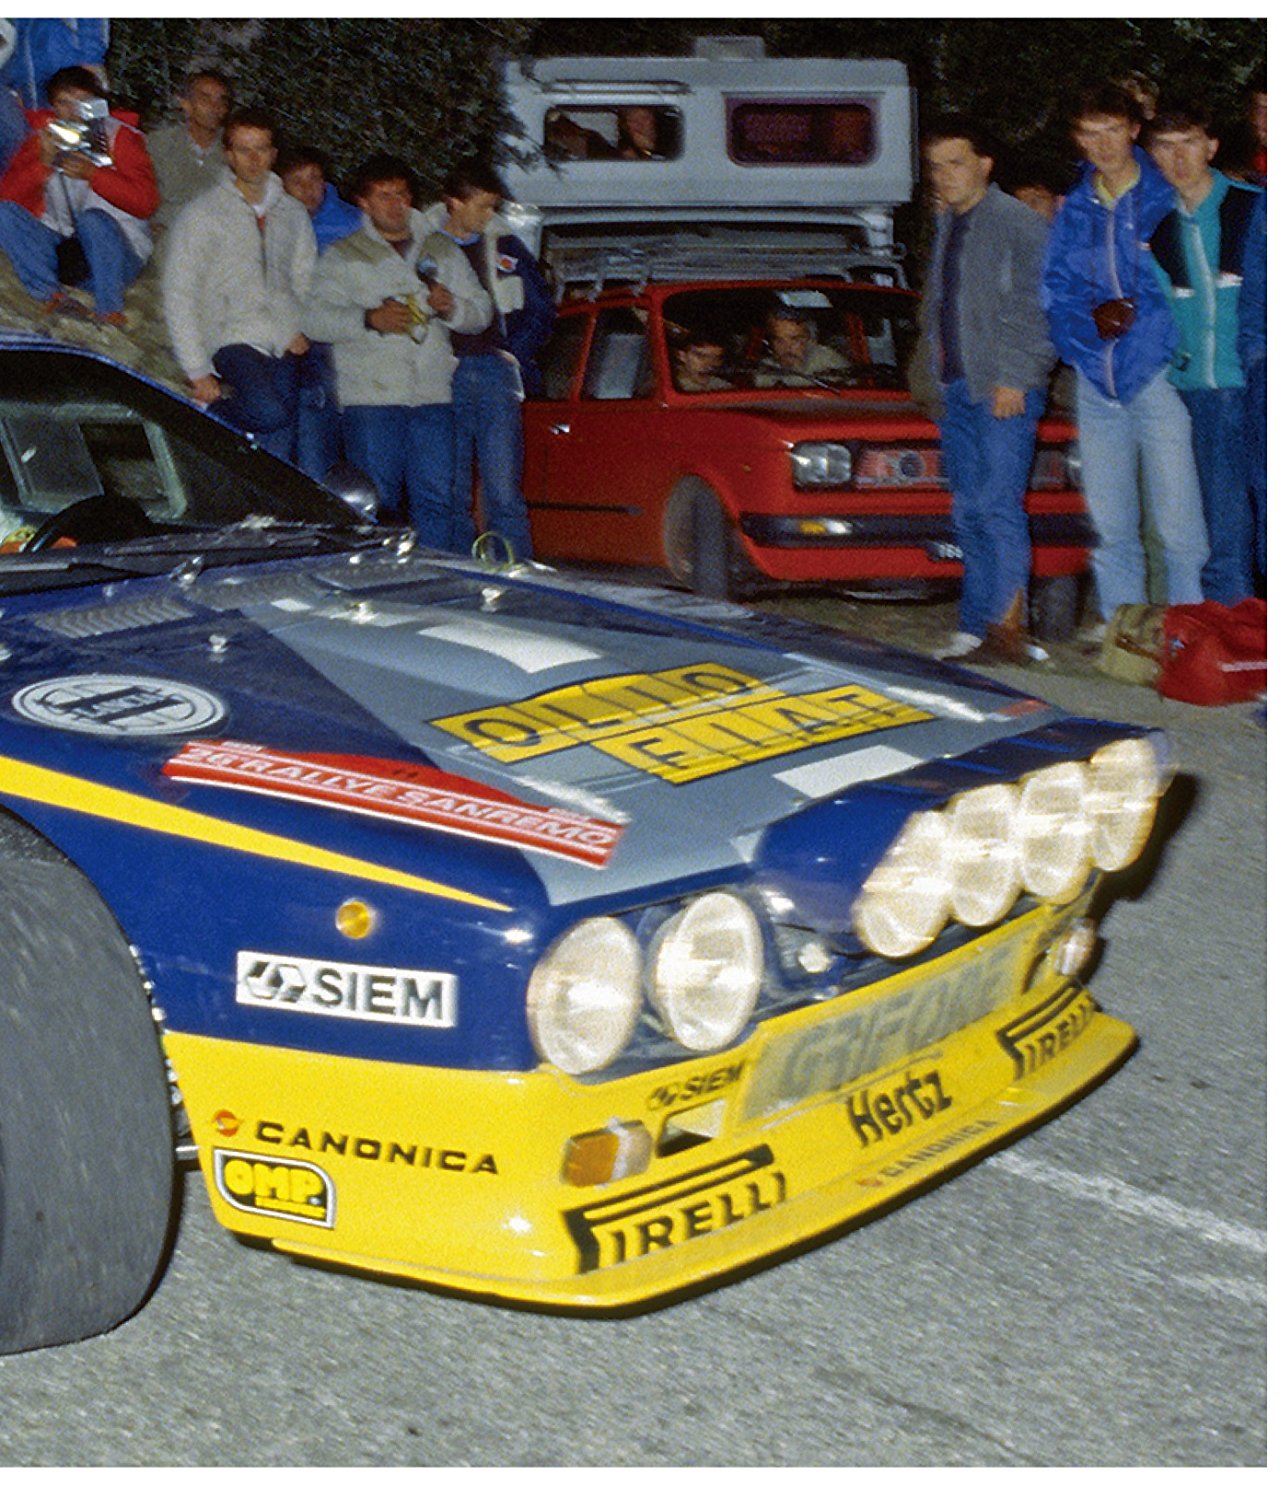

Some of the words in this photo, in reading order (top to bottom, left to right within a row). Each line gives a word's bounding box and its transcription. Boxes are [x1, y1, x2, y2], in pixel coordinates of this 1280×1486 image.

[463, 670, 752, 748] OLIO
[627, 692, 898, 771] FIAT
[237, 758, 397, 799] RALLYE
[395, 788, 616, 846] SANREMO
[313, 967, 446, 1020] SIEM
[679, 1059, 746, 1101] SIEM
[846, 1068, 953, 1148] Hertz
[255, 1119, 500, 1176] CANONICA
[558, 1142, 787, 1276] PIRELLI
